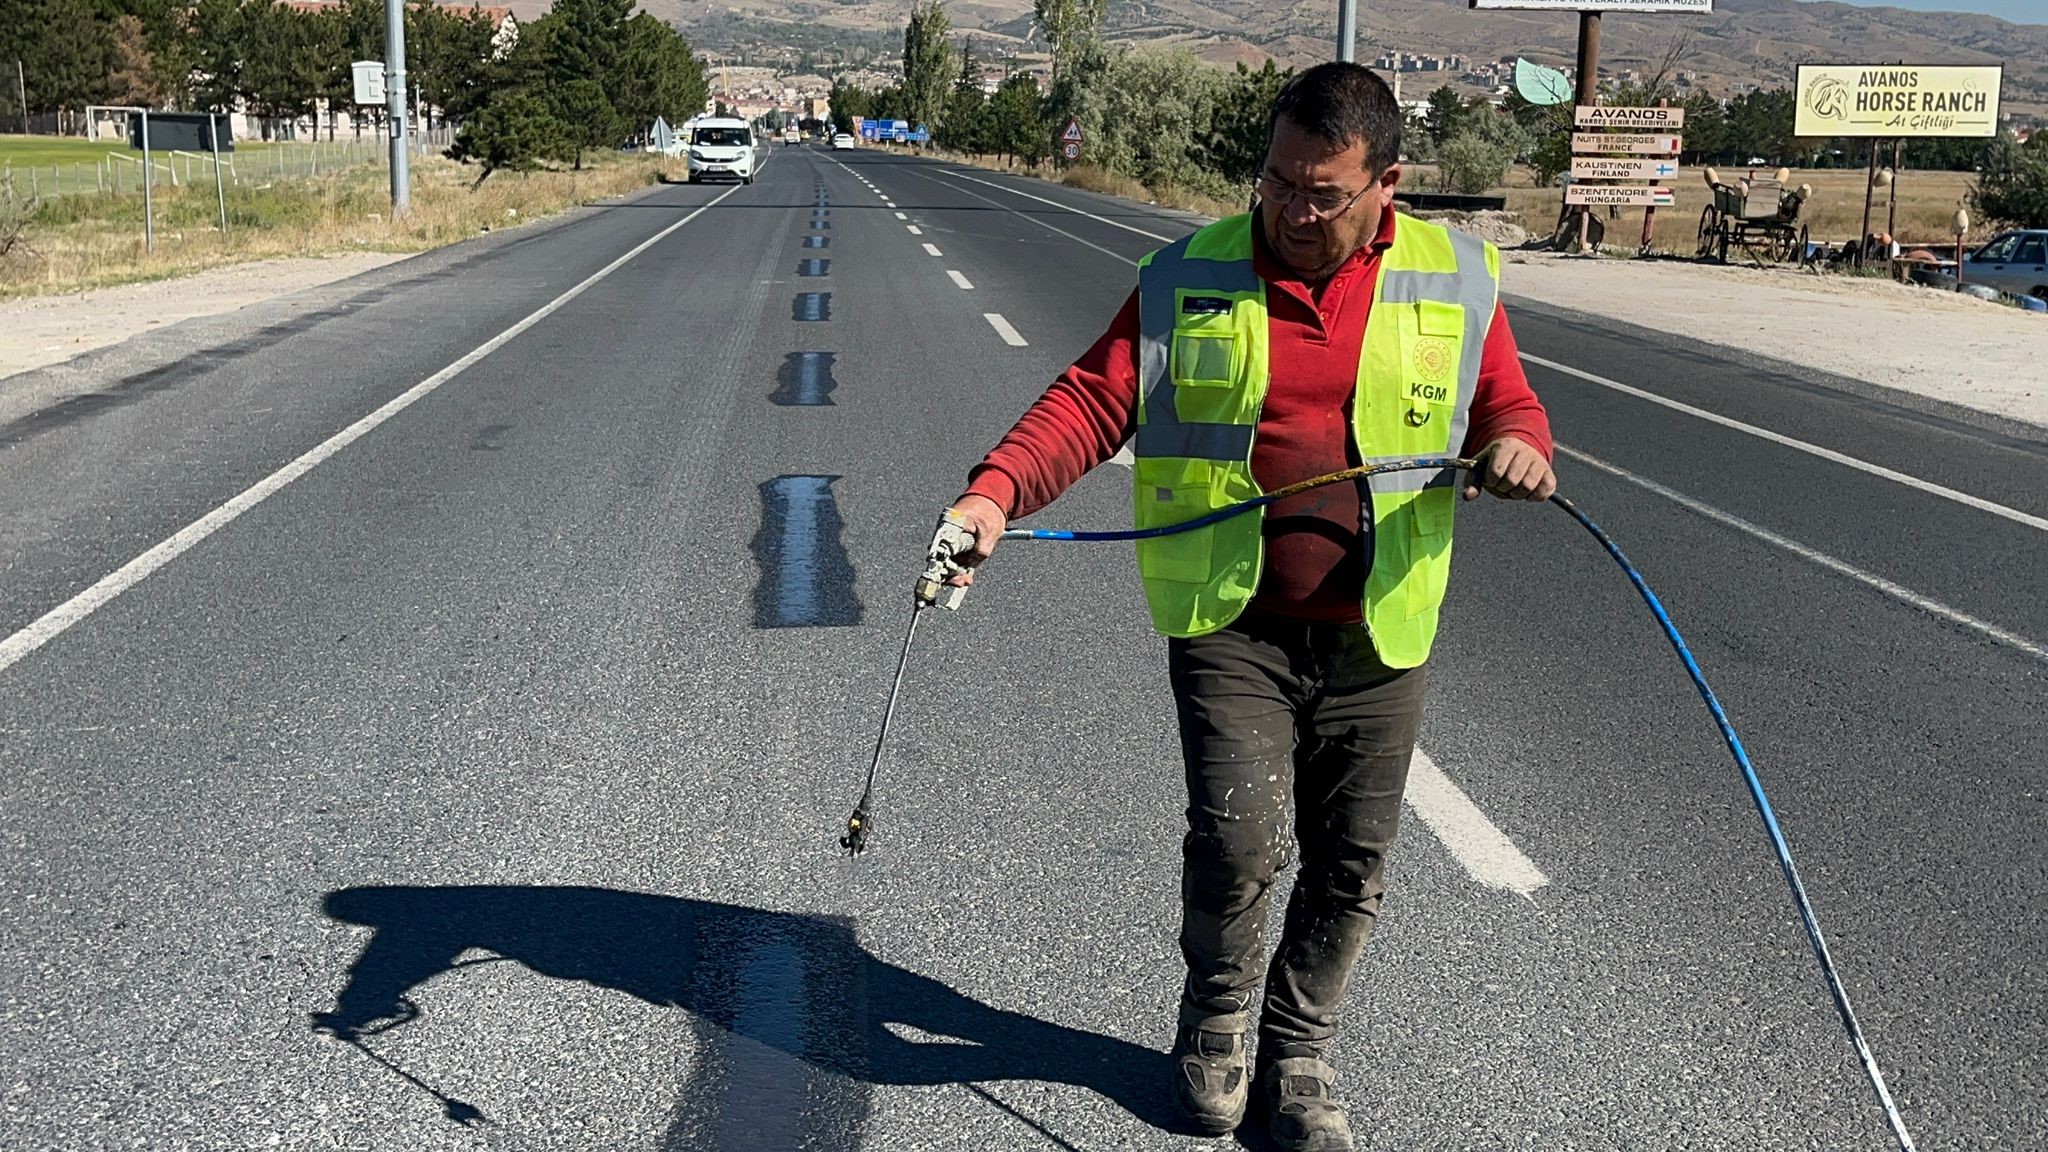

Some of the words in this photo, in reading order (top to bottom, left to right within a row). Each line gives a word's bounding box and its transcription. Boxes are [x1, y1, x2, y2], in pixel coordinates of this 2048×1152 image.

[1858, 71, 1918, 87] AVANOS
[1856, 91, 1917, 112] HORSE
[1922, 92, 1986, 113] RANCH
[1591, 108, 1668, 119] AVANOS
[1885, 114, 1906, 127] At
[1910, 114, 1954, 130] Çiftliği
[1067, 146, 1077, 155] 30
[1570, 188, 1648, 196] SZENTENDRE
[1411, 383, 1447, 402] KGM
